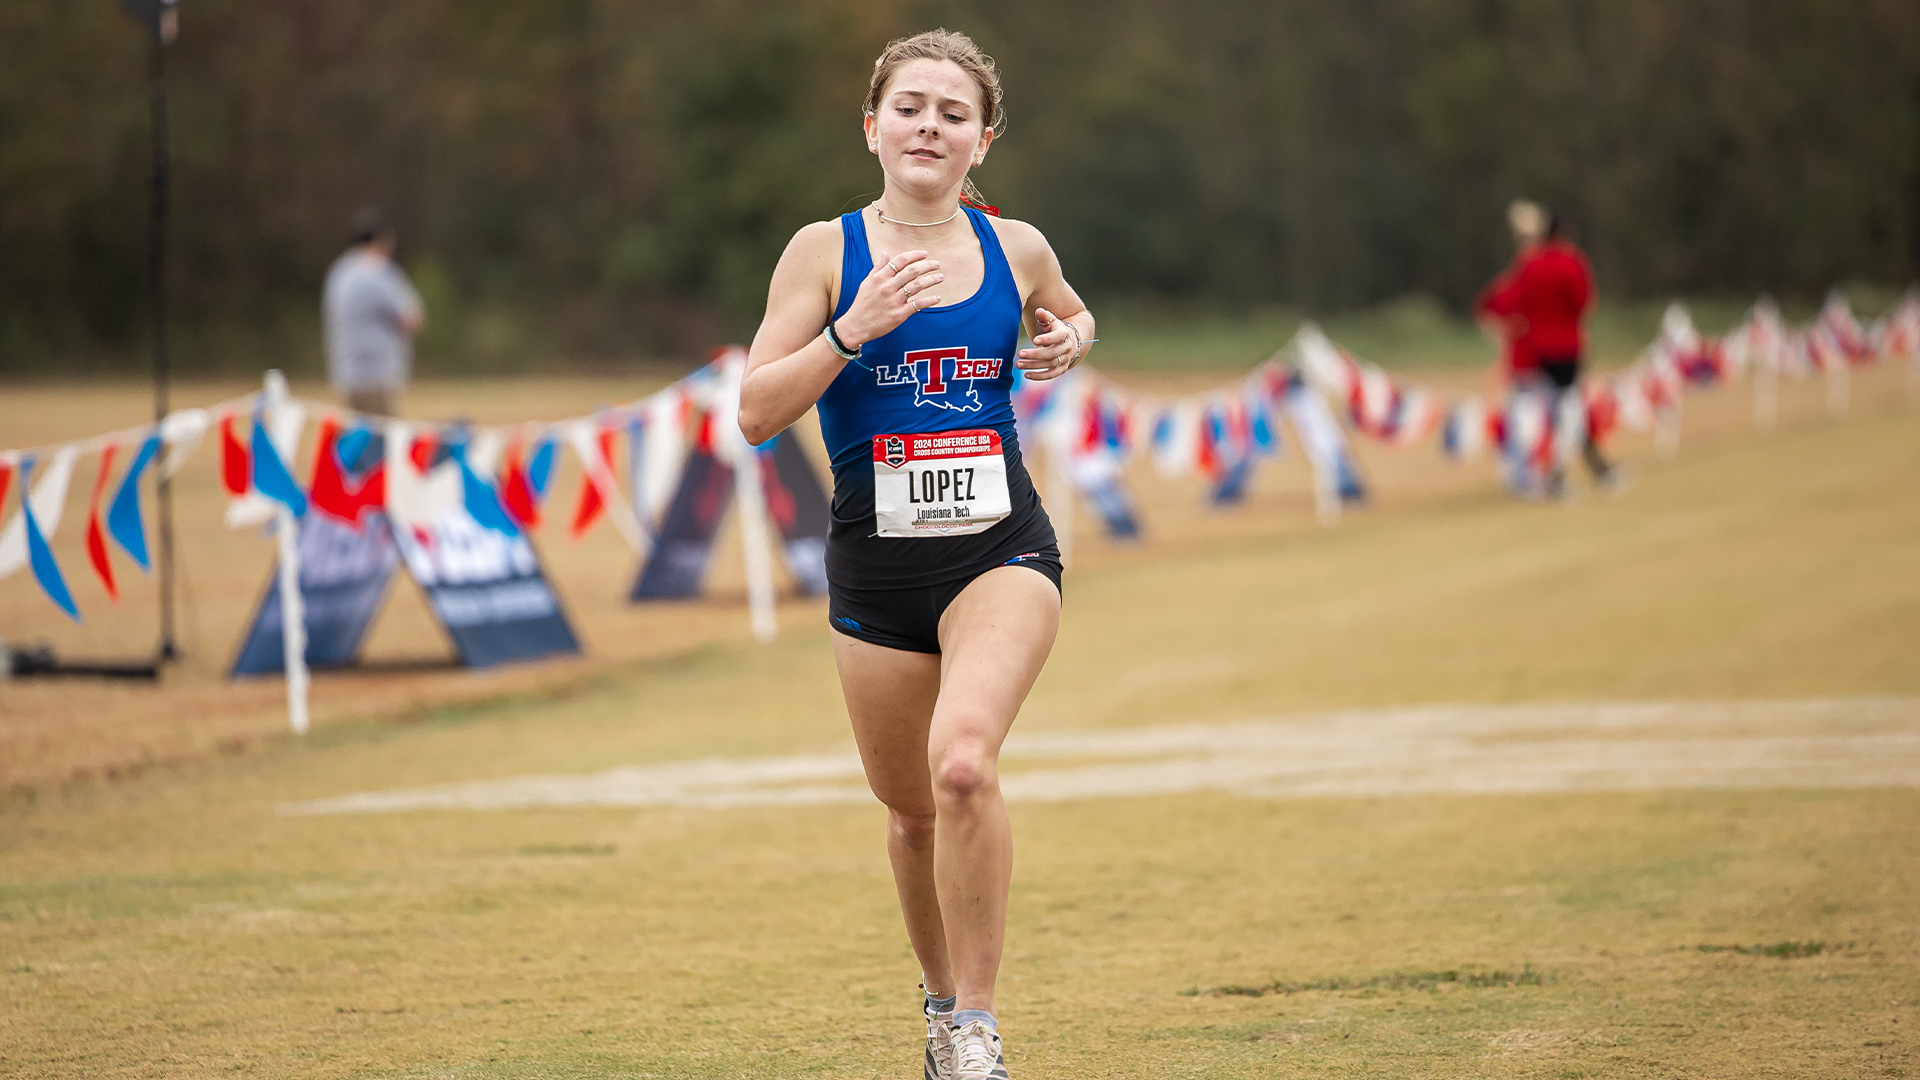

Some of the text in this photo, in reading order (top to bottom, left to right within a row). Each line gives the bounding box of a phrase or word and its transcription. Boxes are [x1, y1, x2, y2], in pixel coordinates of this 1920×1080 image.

[913, 439, 932, 449] 2024
[932, 436, 978, 448] CONFERENCE
[978, 435, 990, 444] USA
[913, 445, 990, 456] CROSS COUNTRY CHAMPIONSHIPS
[909, 467, 976, 504] LOPEZ
[917, 505, 970, 519] Louisiana Tech
